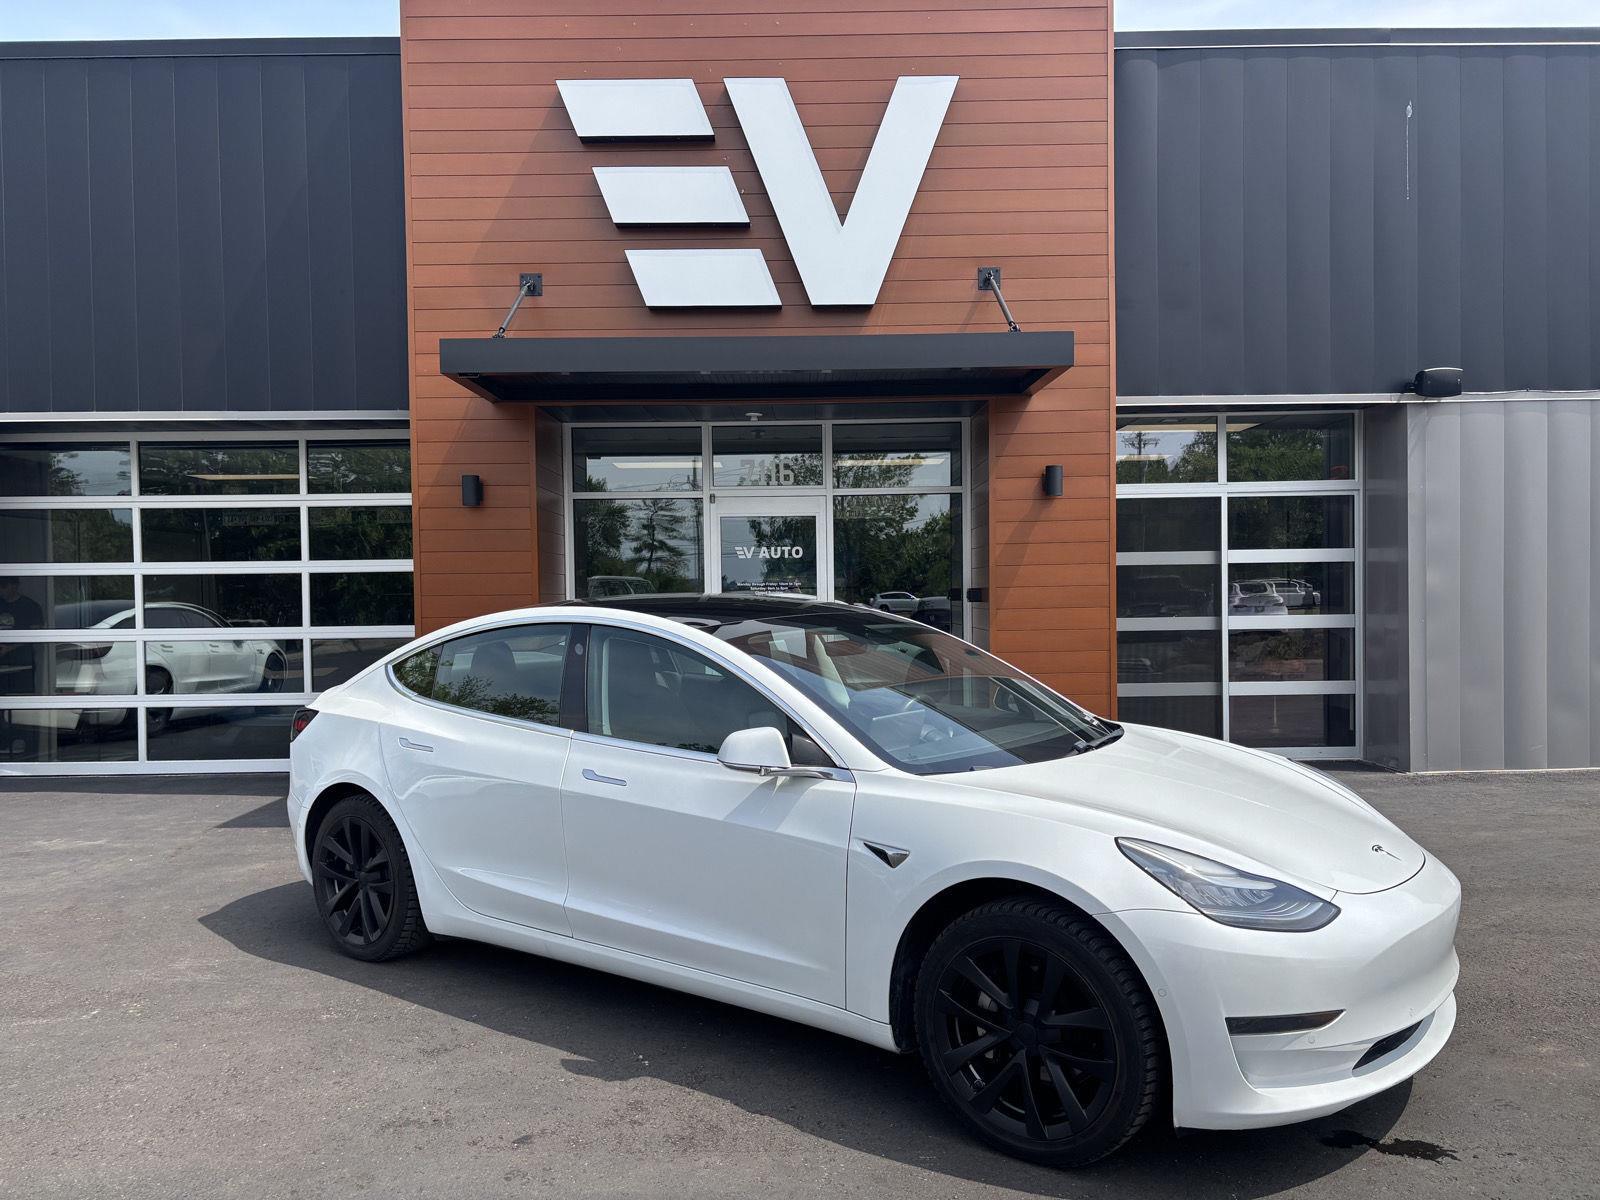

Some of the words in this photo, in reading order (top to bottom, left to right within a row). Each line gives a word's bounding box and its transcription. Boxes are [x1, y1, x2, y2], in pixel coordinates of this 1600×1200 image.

[555, 75, 960, 307] EV
[734, 546, 755, 559] EV
[759, 546, 804, 559] AUTO
